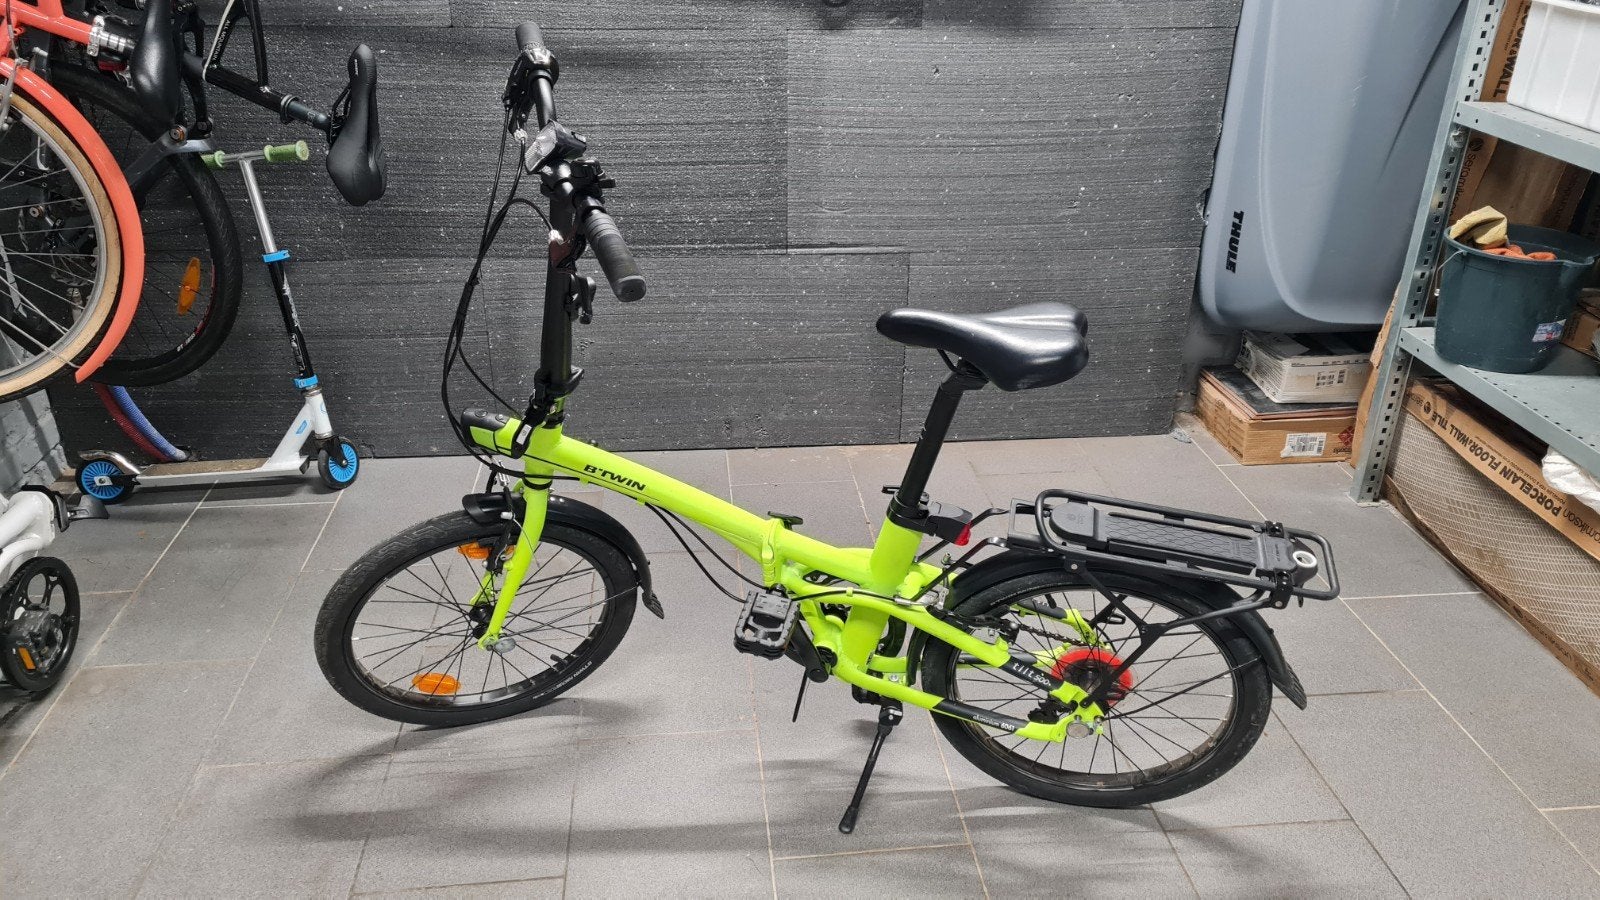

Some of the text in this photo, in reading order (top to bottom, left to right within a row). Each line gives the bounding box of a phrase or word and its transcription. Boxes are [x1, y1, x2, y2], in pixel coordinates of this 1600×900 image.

[1226, 211, 1244, 274] THULE
[1431, 413, 1448, 430] TILE
[1499, 465, 1562, 517] PORCELAIN
